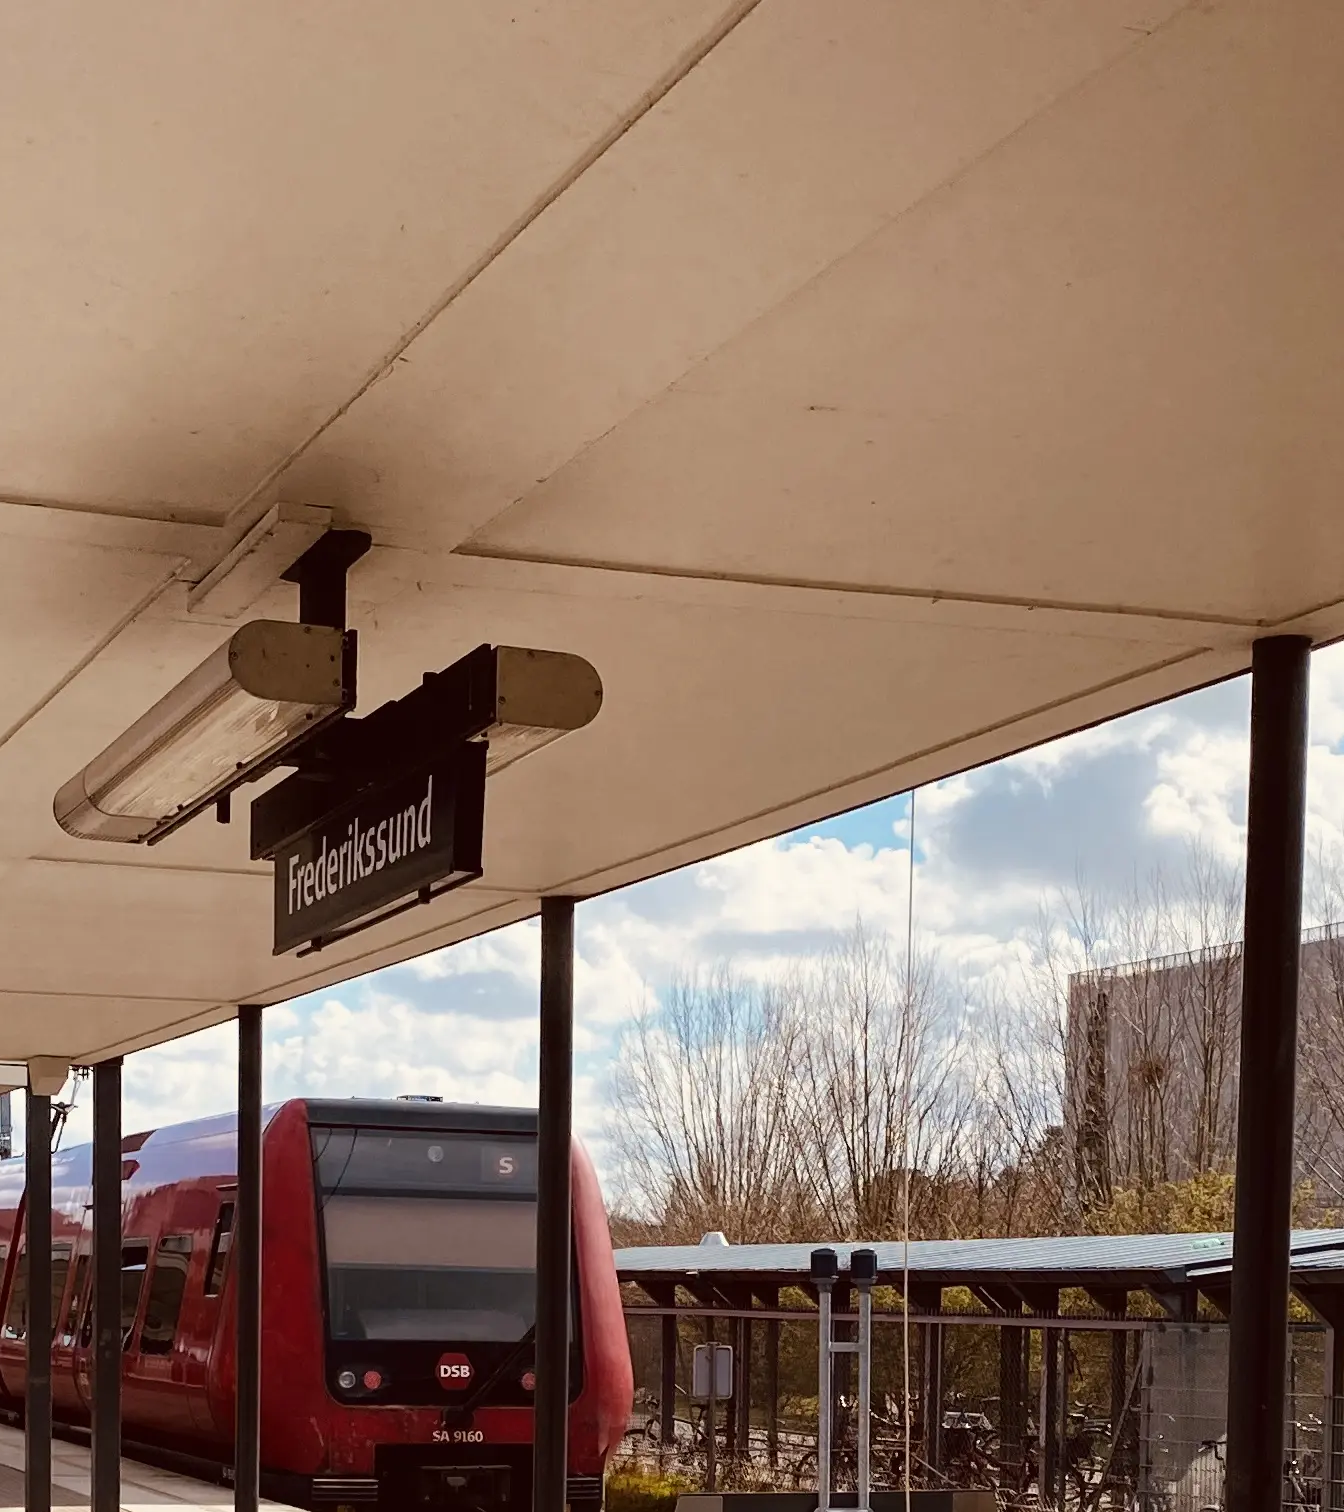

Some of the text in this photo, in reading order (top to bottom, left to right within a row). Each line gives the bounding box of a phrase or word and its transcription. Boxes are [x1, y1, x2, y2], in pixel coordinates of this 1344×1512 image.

[288, 774, 433, 916] Frederikssund
[499, 1156, 514, 1174] S
[439, 1364, 471, 1379] DSB
[432, 1429, 484, 1443] SA 9160
